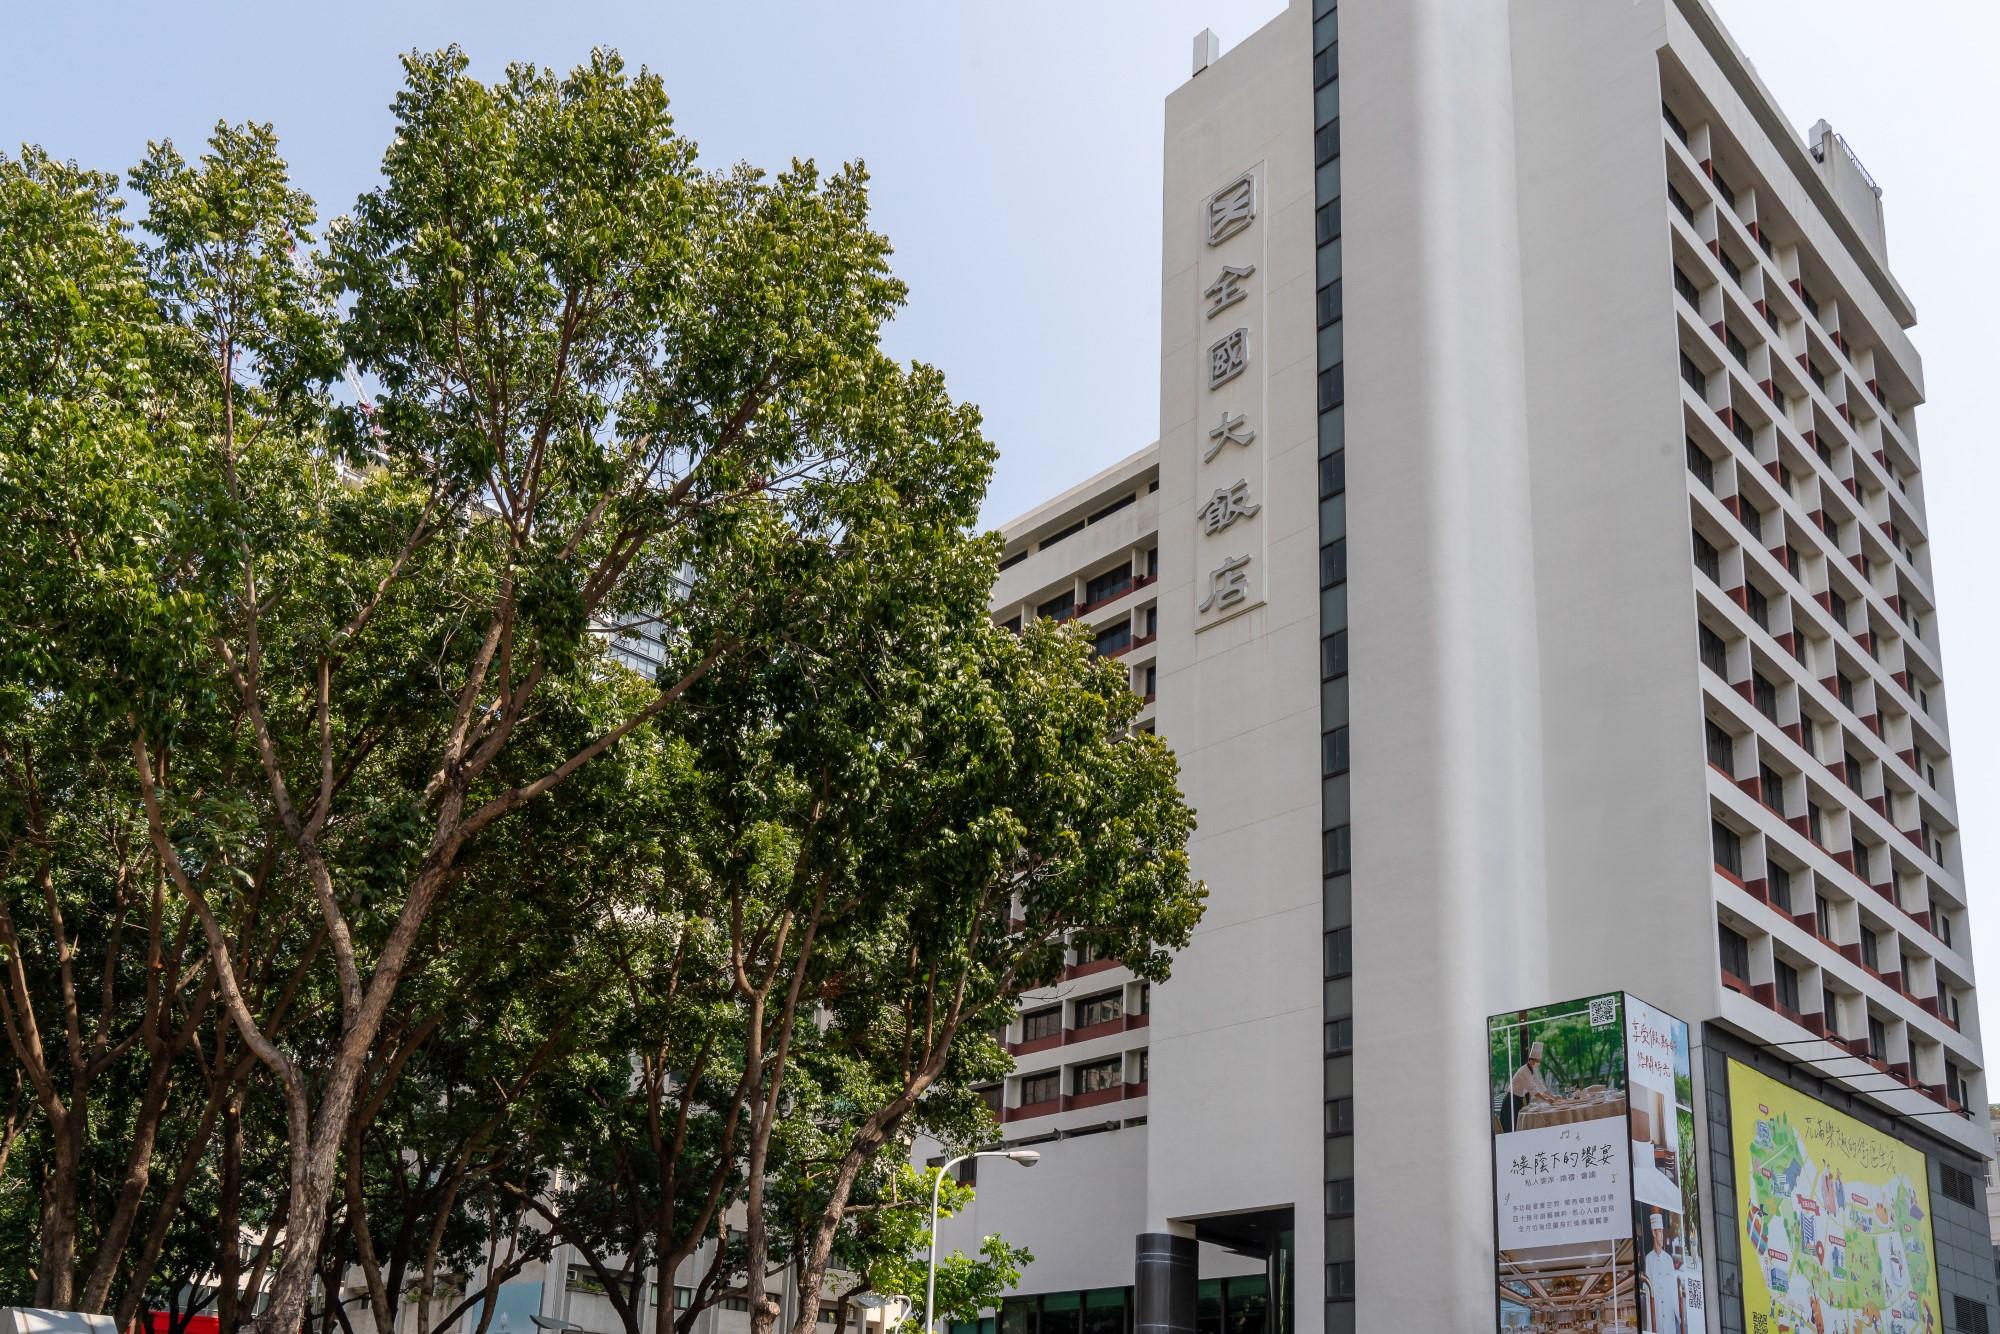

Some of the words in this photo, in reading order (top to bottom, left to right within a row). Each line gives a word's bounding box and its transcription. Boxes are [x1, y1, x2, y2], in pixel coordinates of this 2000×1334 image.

[1199, 264, 1262, 613] 全國大飯店
[1510, 1144, 1615, 1176] 綠蔭下的饗宴
